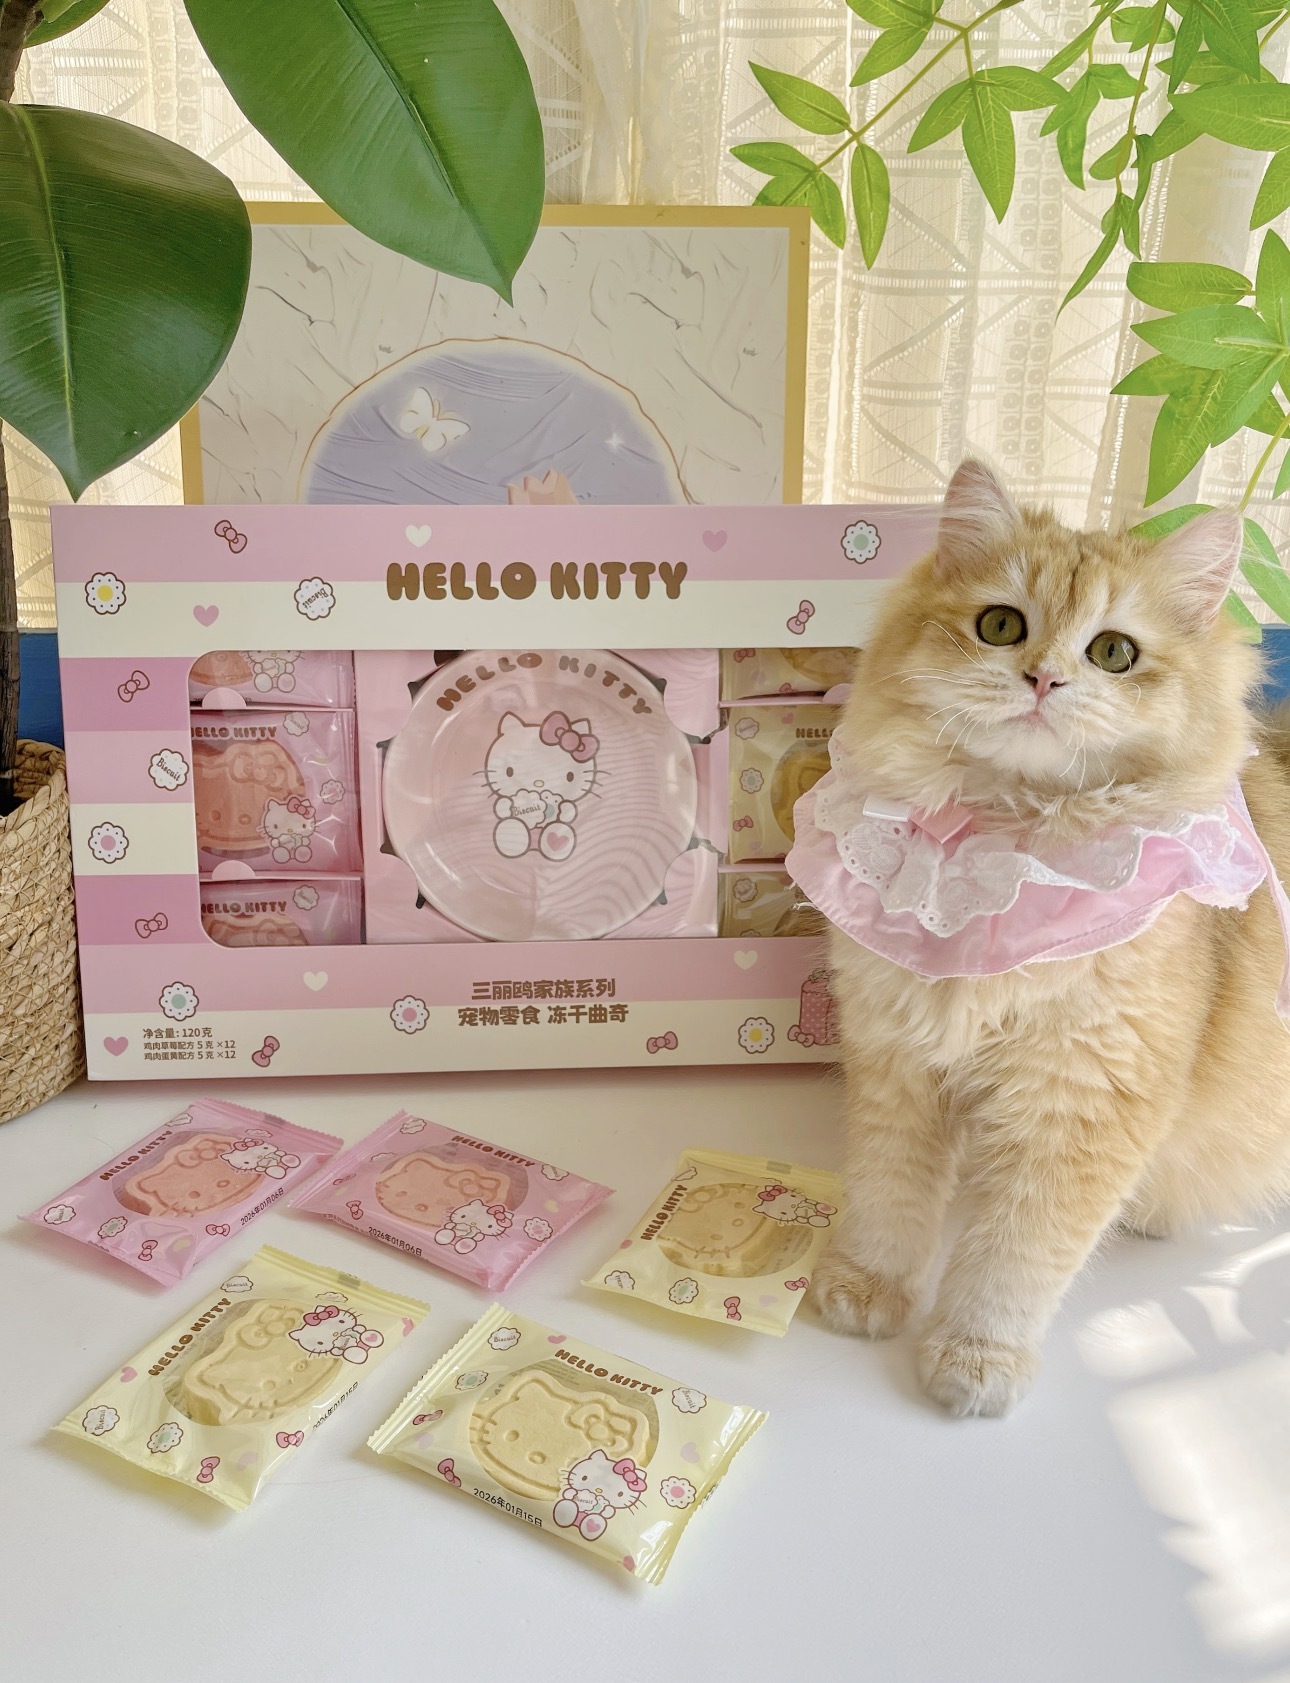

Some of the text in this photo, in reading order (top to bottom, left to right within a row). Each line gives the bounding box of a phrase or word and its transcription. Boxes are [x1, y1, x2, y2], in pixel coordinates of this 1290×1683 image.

[386, 561, 688, 600] HELLO KITTY
[302, 587, 329, 610] Biscuit
[436, 652, 652, 714] HELLO KITTY
[233, 726, 277, 738] KITTY
[795, 728, 835, 739] HELL
[156, 757, 181, 781] Biscuit
[510, 803, 541, 817] Biscuit
[244, 901, 287, 913] KITTY
[471, 978, 616, 1000] 三丽鸥家族系列
[458, 1003, 629, 1026] 宠物零食 冻干曲奇
[99, 1130, 173, 1181] HELLO KITTY
[451, 1135, 535, 1167] HELLO KITTY
[240, 1187, 284, 1225] 2026年01月06日
[640, 1184, 688, 1241] HELLO KITTY
[368, 1226, 422, 1257] 2026年01月06日
[147, 1297, 231, 1376] HELLO KITTY
[554, 1349, 609, 1377] HELLO
[609, 1373, 664, 1395] KITTY
[473, 1487, 542, 1528] 2026年01月15日
